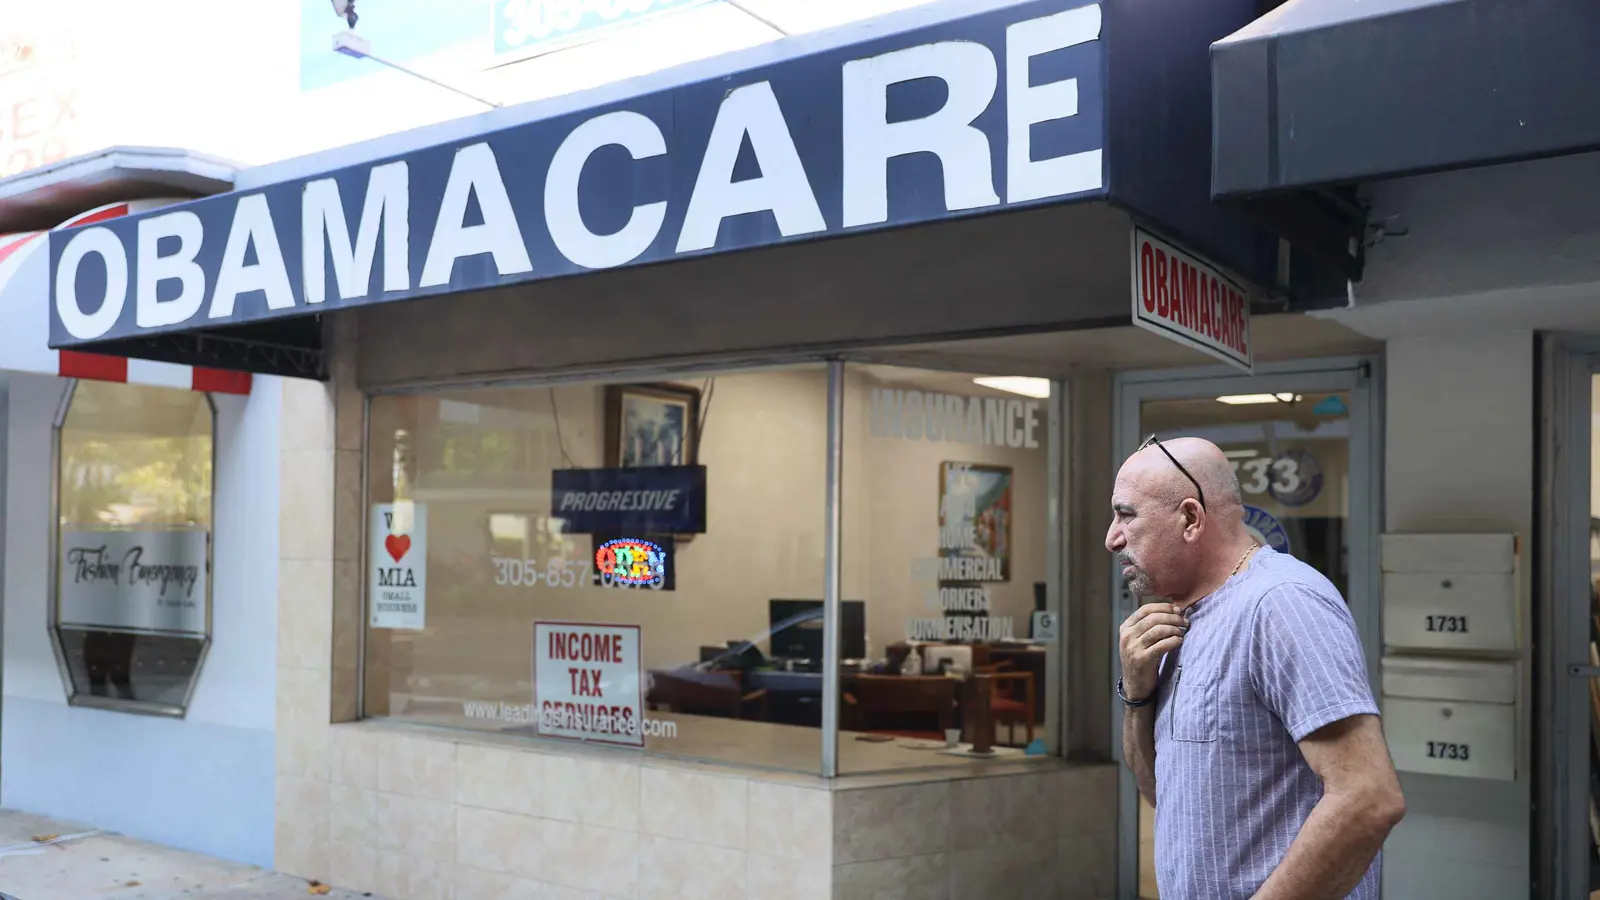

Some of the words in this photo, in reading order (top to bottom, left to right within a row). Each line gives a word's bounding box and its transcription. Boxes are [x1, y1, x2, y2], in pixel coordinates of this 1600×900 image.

[55, 3, 1103, 340] OBAMACARE
[1141, 241, 1248, 356] OBAMACARE
[870, 388, 1039, 449] INSURANCE
[560, 489, 681, 511] PROGRESSIVE
[596, 545, 667, 578] OPEN
[377, 567, 418, 588] MIA
[1425, 615, 1469, 633] 1731
[548, 632, 623, 663] INCOME
[568, 668, 603, 697] TAX
[1426, 741, 1470, 760] 1733
